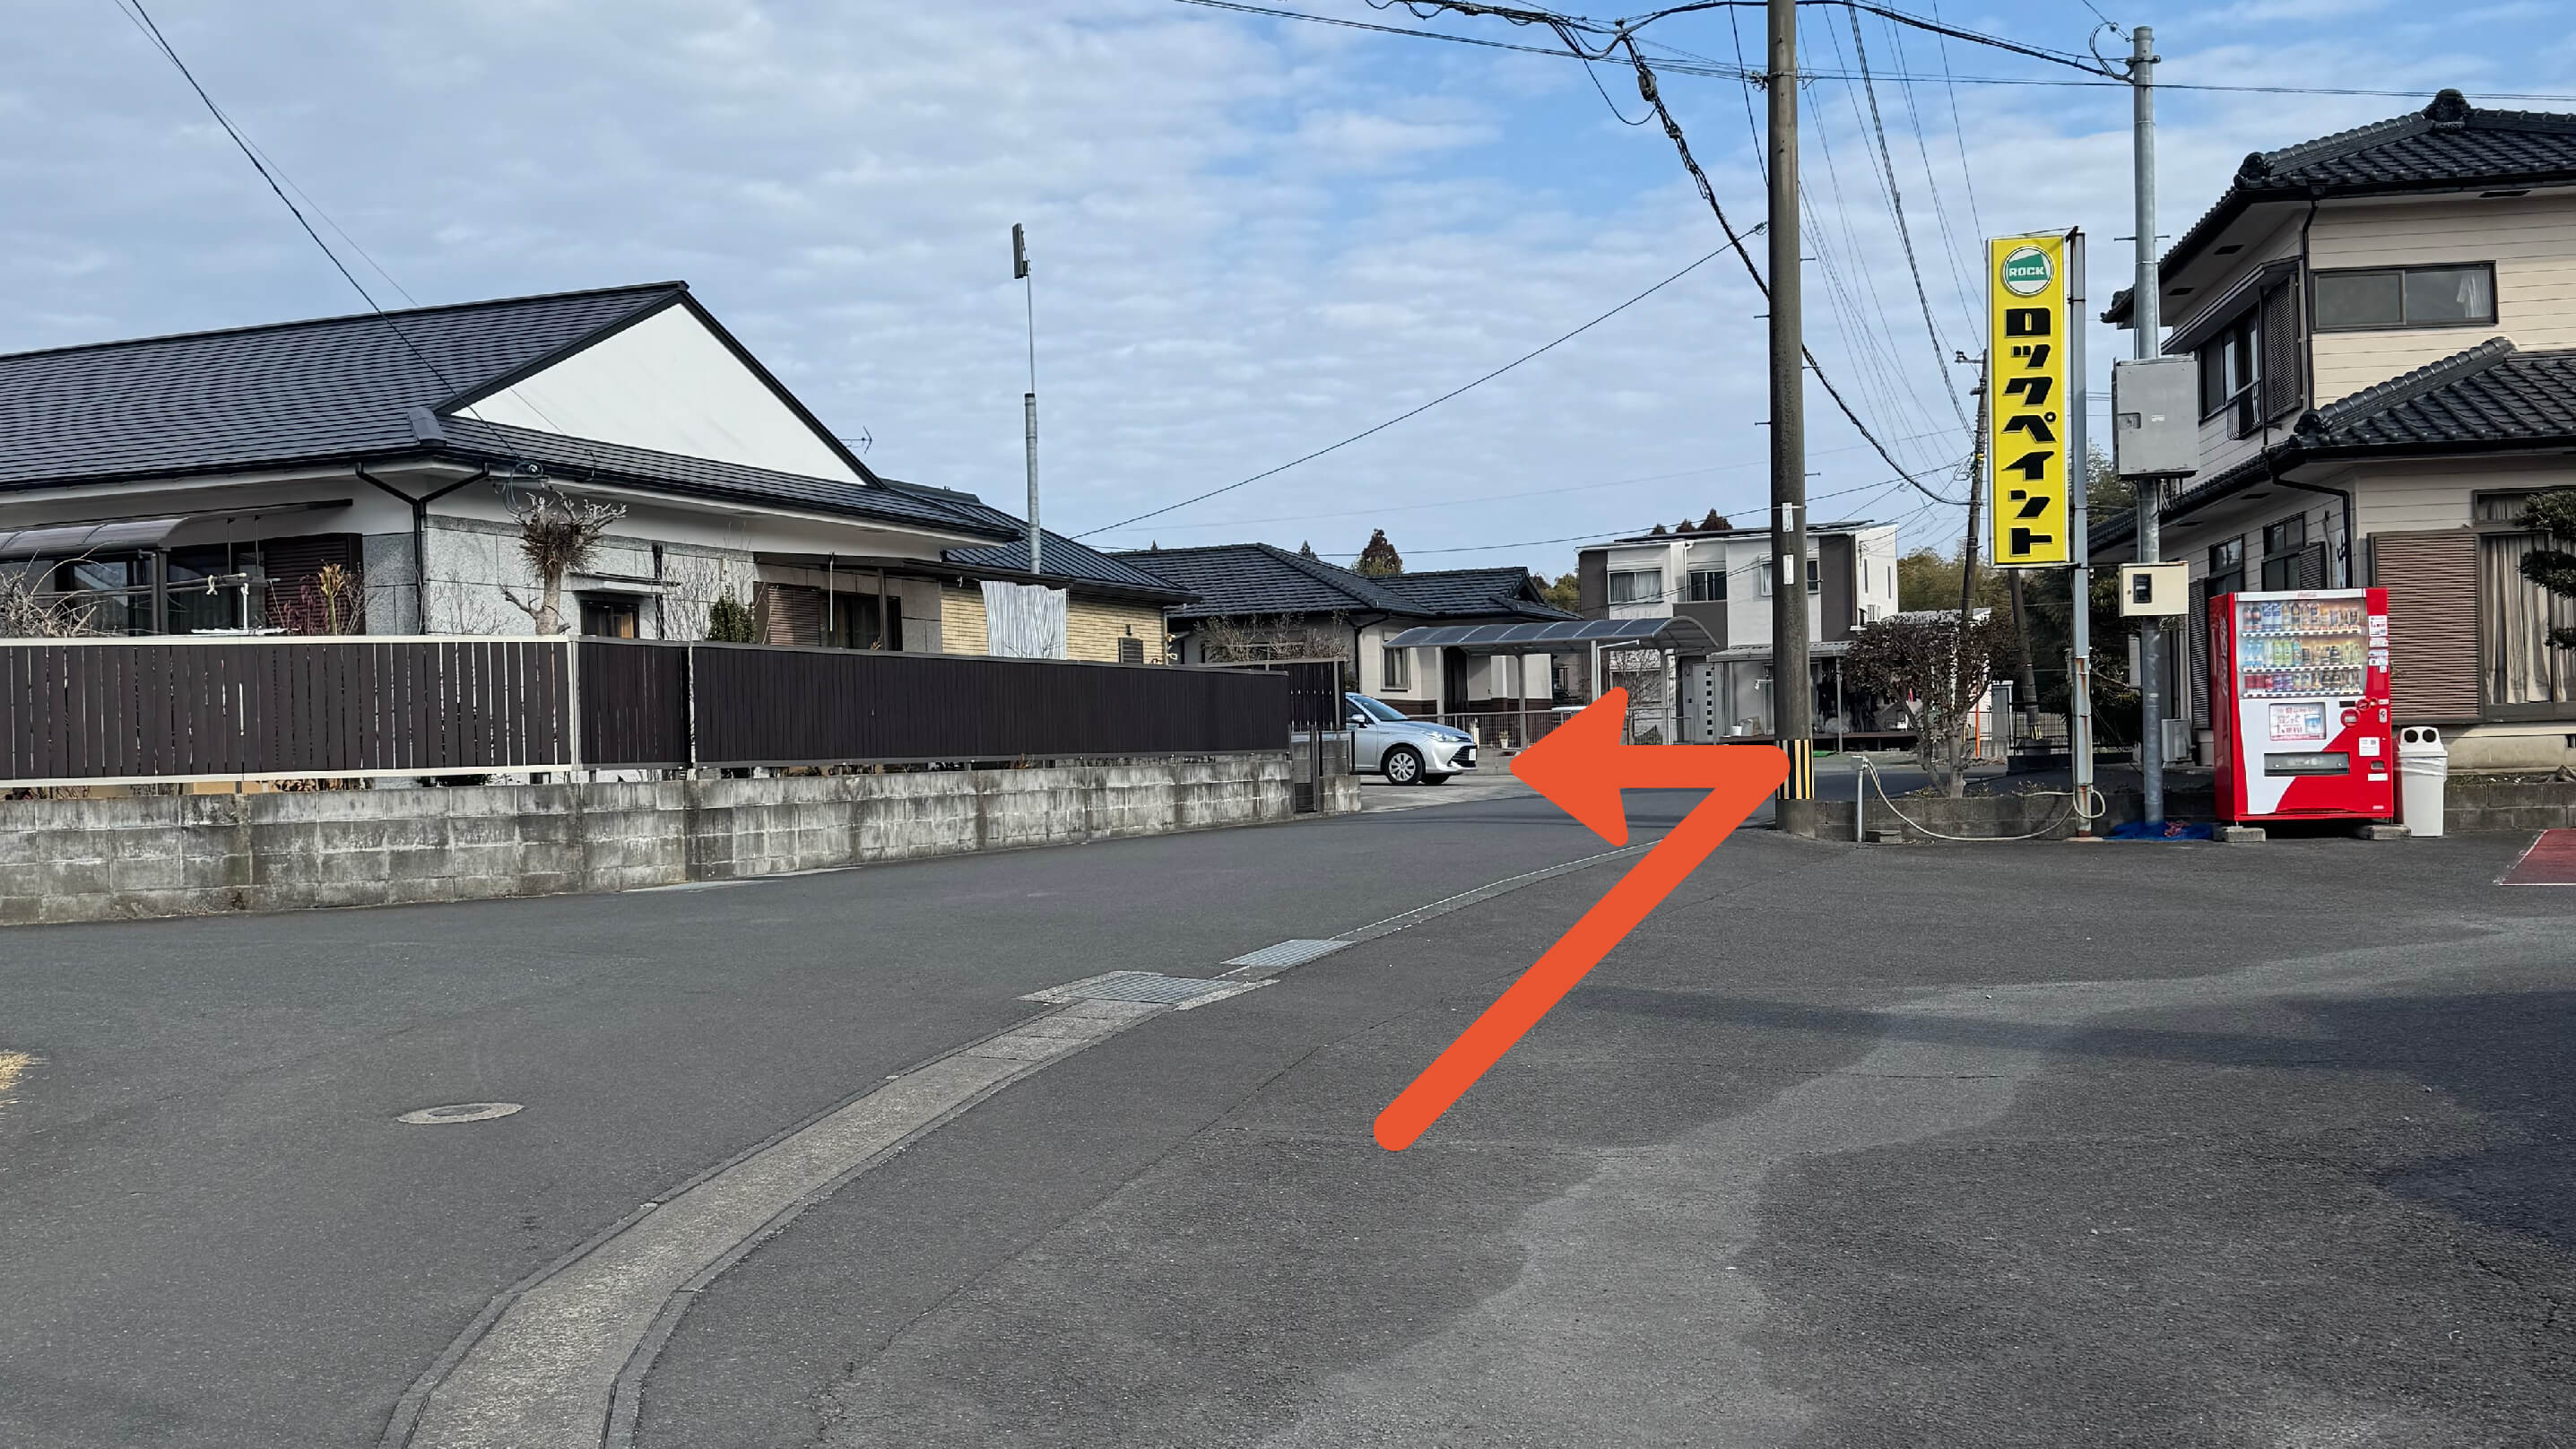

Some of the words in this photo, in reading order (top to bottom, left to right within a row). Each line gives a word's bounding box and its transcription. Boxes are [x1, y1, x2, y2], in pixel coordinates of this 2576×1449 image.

[2008, 266, 2045, 277] ROCK
[2001, 308, 2057, 557] ロックペイント
